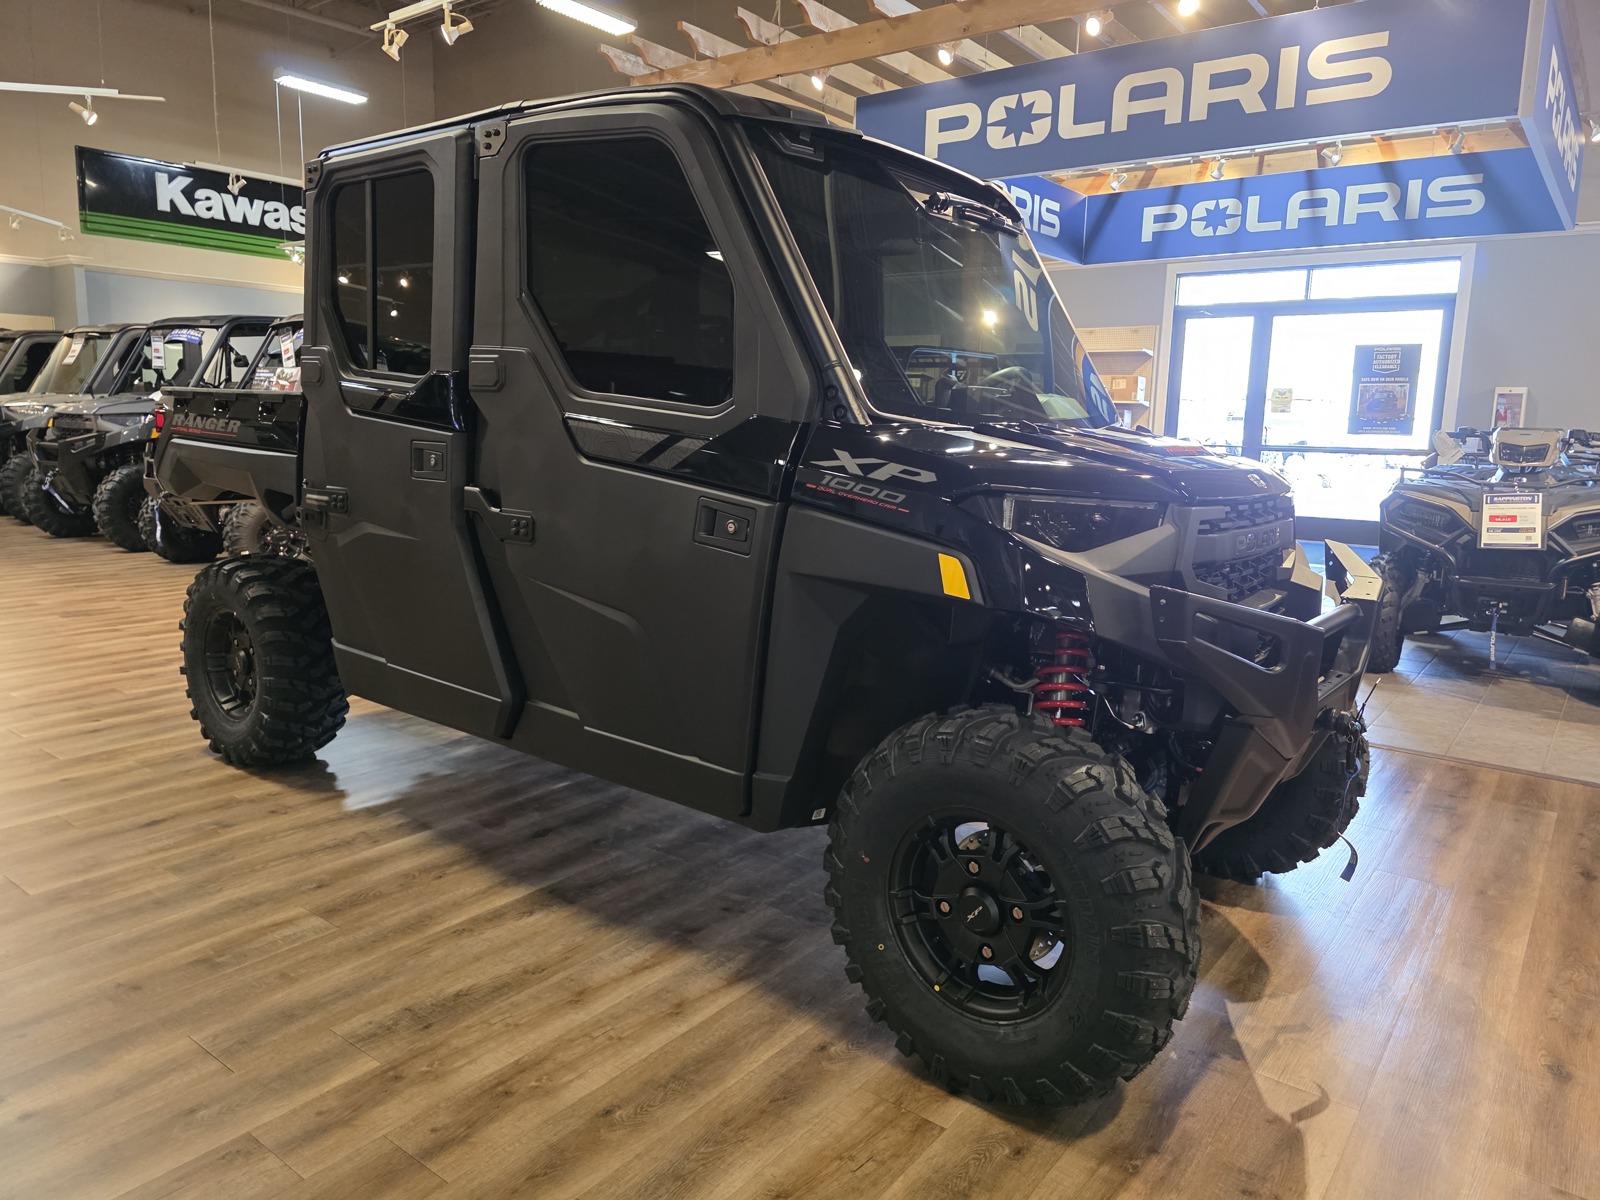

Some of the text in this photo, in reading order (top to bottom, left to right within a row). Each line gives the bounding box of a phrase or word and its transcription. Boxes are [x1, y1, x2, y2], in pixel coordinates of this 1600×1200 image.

[924, 31, 1392, 159] POLARIS
[1545, 44, 1579, 192] POLARIS
[155, 171, 306, 235] Kawas
[1141, 173, 1486, 243] POLARIS
[172, 413, 241, 433] RANGER
[809, 448, 938, 483] XP
[816, 486, 898, 511] DUAL OVERHEAD CAM
[821, 475, 906, 504] 1000
[966, 905, 983, 923] XP
